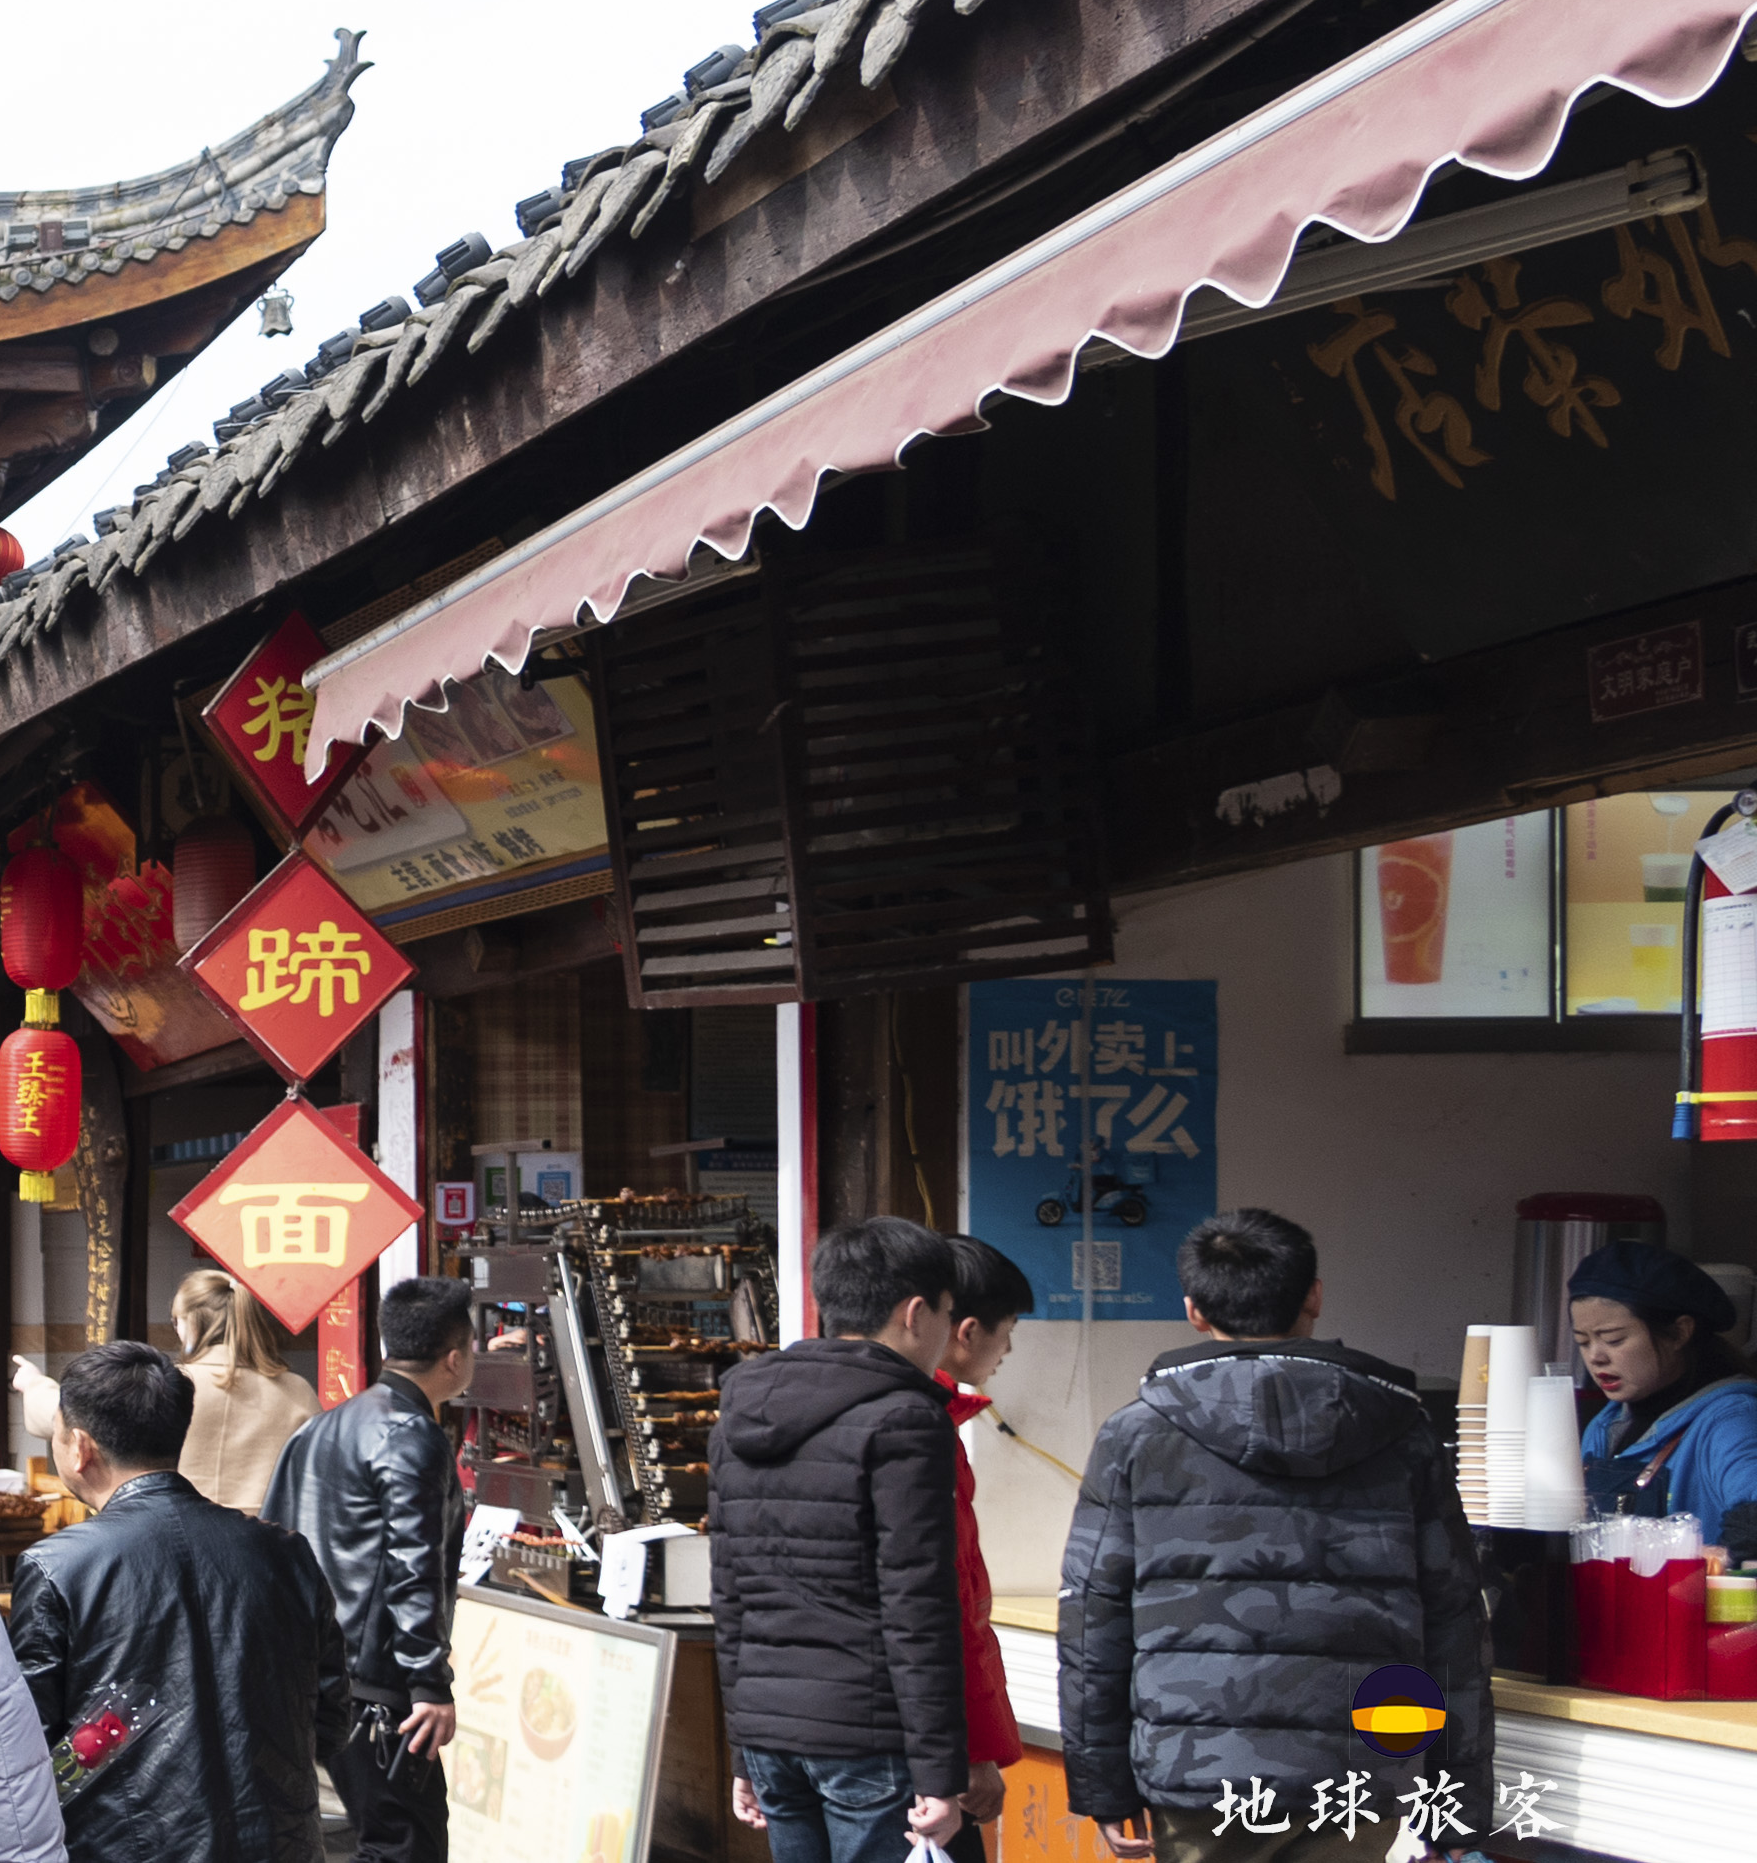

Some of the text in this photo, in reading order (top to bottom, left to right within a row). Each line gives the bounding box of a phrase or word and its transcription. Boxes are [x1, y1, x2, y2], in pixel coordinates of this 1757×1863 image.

[988, 1020, 1199, 1078] 叫外卖上
[985, 1080, 1201, 1158] 饿了么
